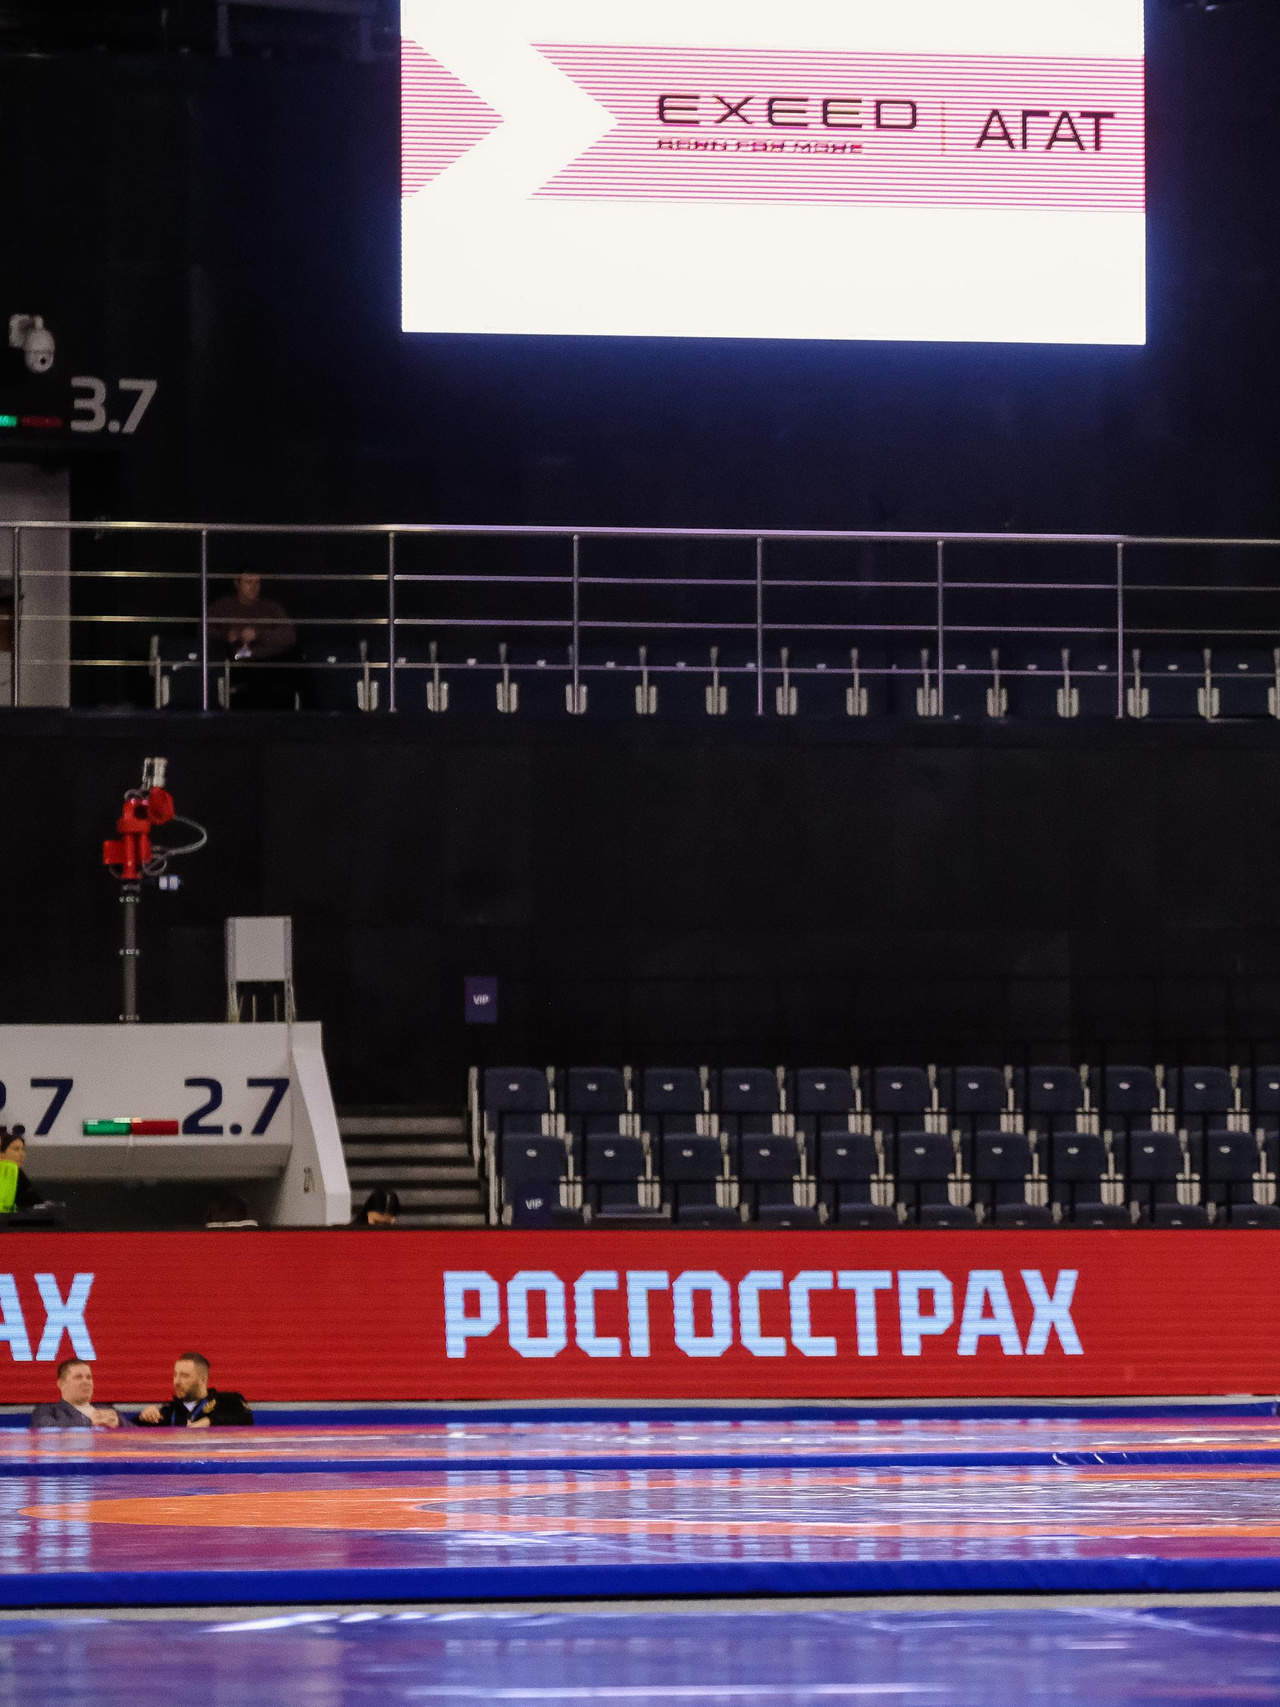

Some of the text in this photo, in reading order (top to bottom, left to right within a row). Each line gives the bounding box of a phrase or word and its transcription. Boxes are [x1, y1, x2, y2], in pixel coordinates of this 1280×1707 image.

[657, 94, 917, 130] EXEED
[975, 109, 1115, 151] АГАТ
[70, 376, 157, 434] 3.7
[0, 1077, 74, 1136] .7
[182, 1077, 290, 1136] 2.7
[443, 1269, 1084, 1358] РОСГОССТРАХ
